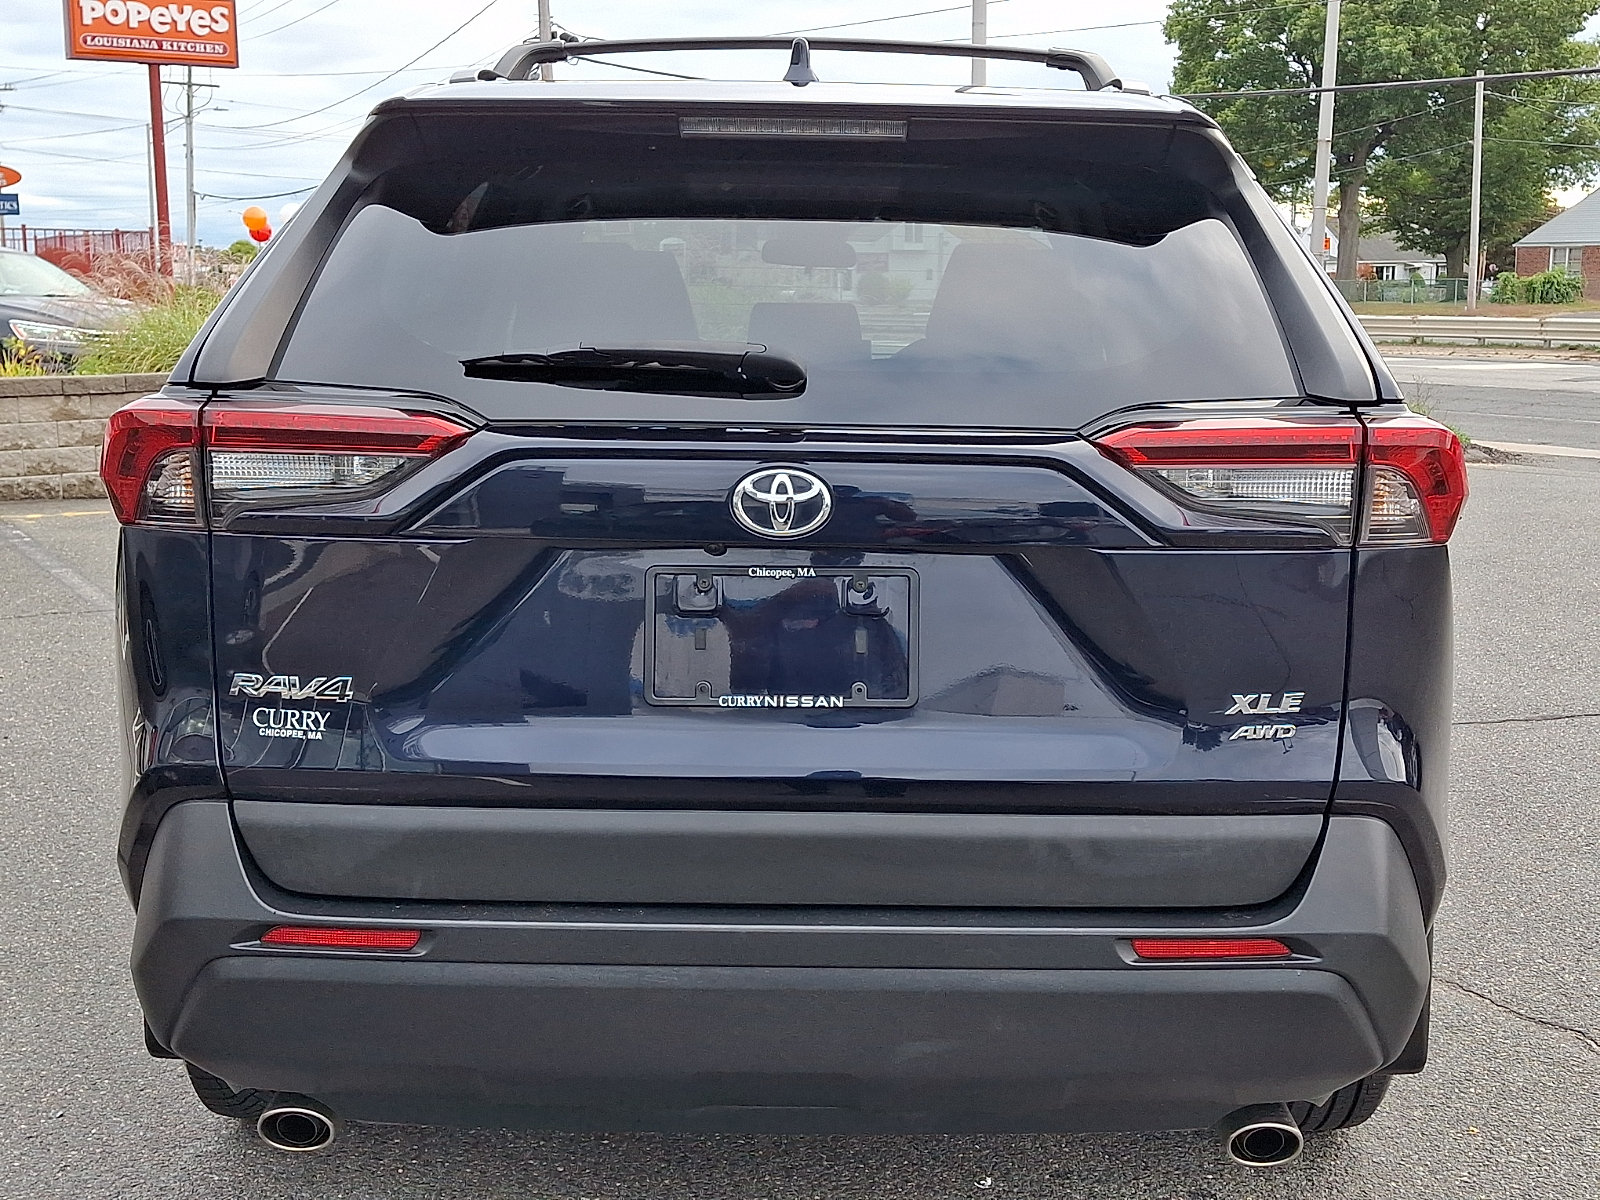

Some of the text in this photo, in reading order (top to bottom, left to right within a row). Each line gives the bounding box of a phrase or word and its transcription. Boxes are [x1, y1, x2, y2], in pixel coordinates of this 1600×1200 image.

[86, 36, 224, 54] LOUISIANA KITCHEN
[748, 567, 817, 579] Chicopee, MA
[229, 672, 353, 702] RAV4
[1224, 691, 1306, 715] XLE
[252, 707, 331, 731] CURRY
[259, 728, 323, 740] CHICOPEE, MA
[1228, 724, 1297, 741] AWD
